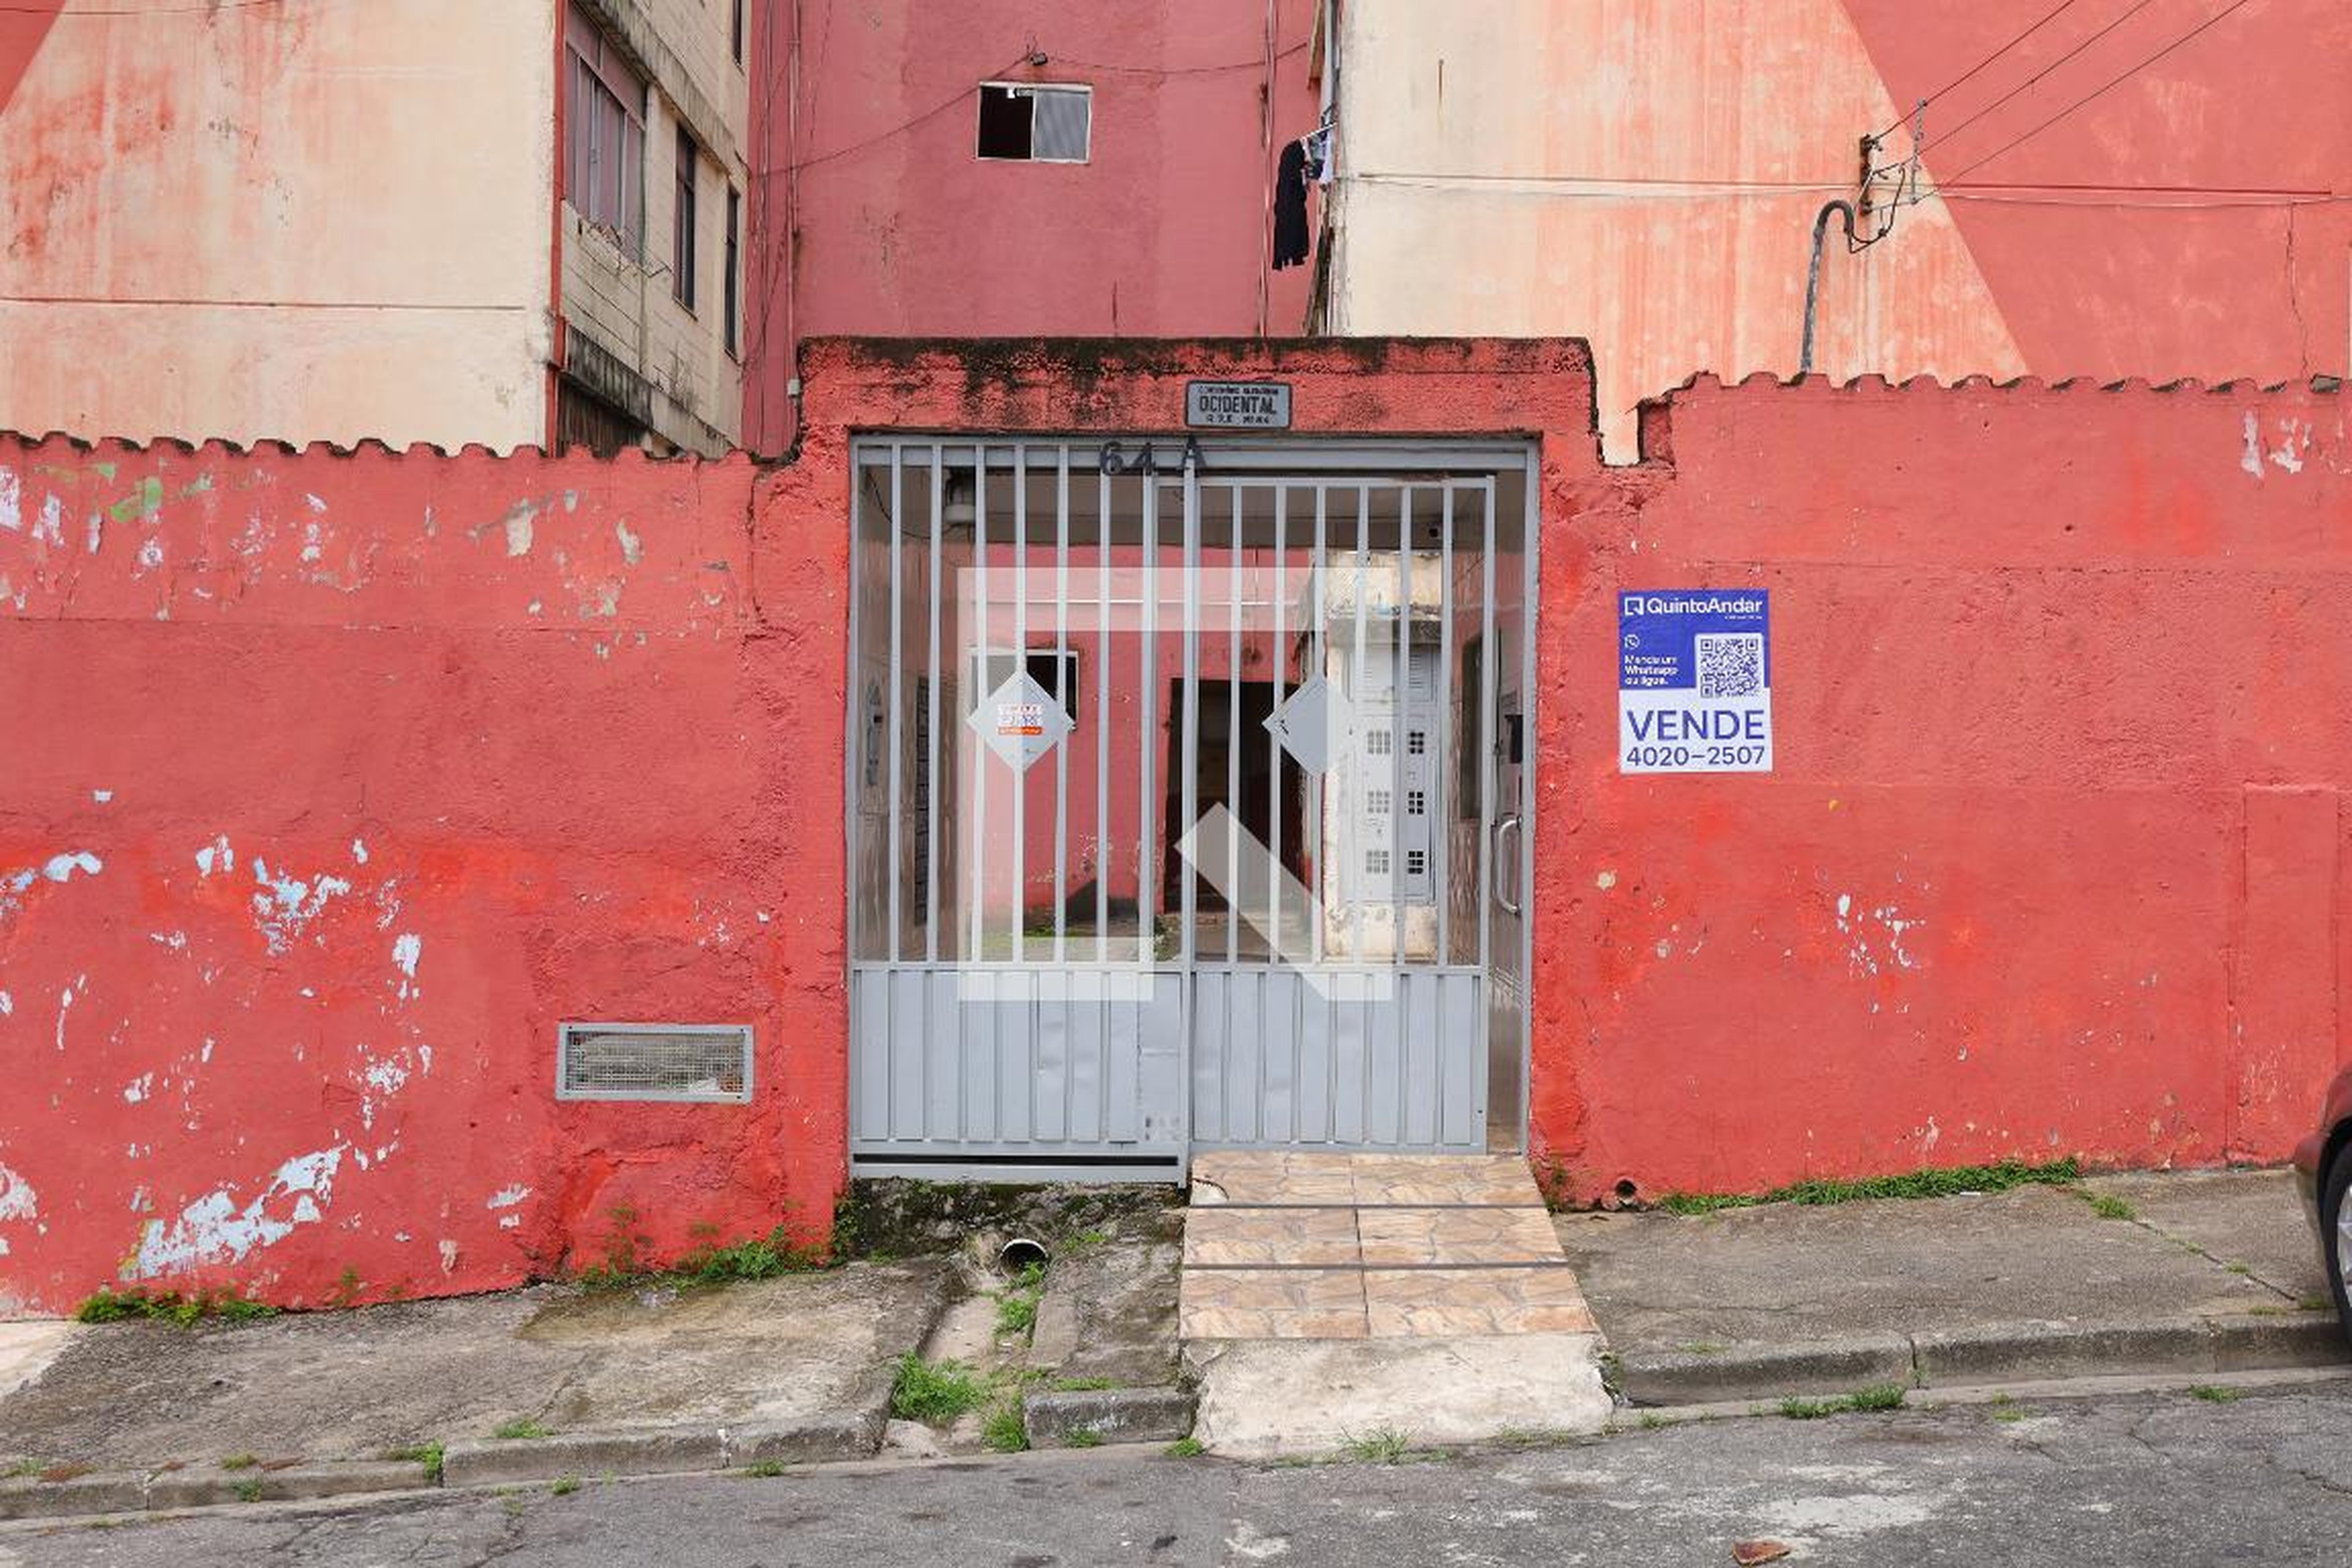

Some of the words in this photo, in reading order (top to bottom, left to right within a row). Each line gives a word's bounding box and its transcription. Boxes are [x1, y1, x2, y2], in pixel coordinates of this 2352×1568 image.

[1199, 396, 1277, 414] OCIDENTAL
[1646, 597, 1763, 614] QuintoAndar
[1627, 710, 1765, 741] VENDE
[1626, 746, 1765, 766] 4020-2507
